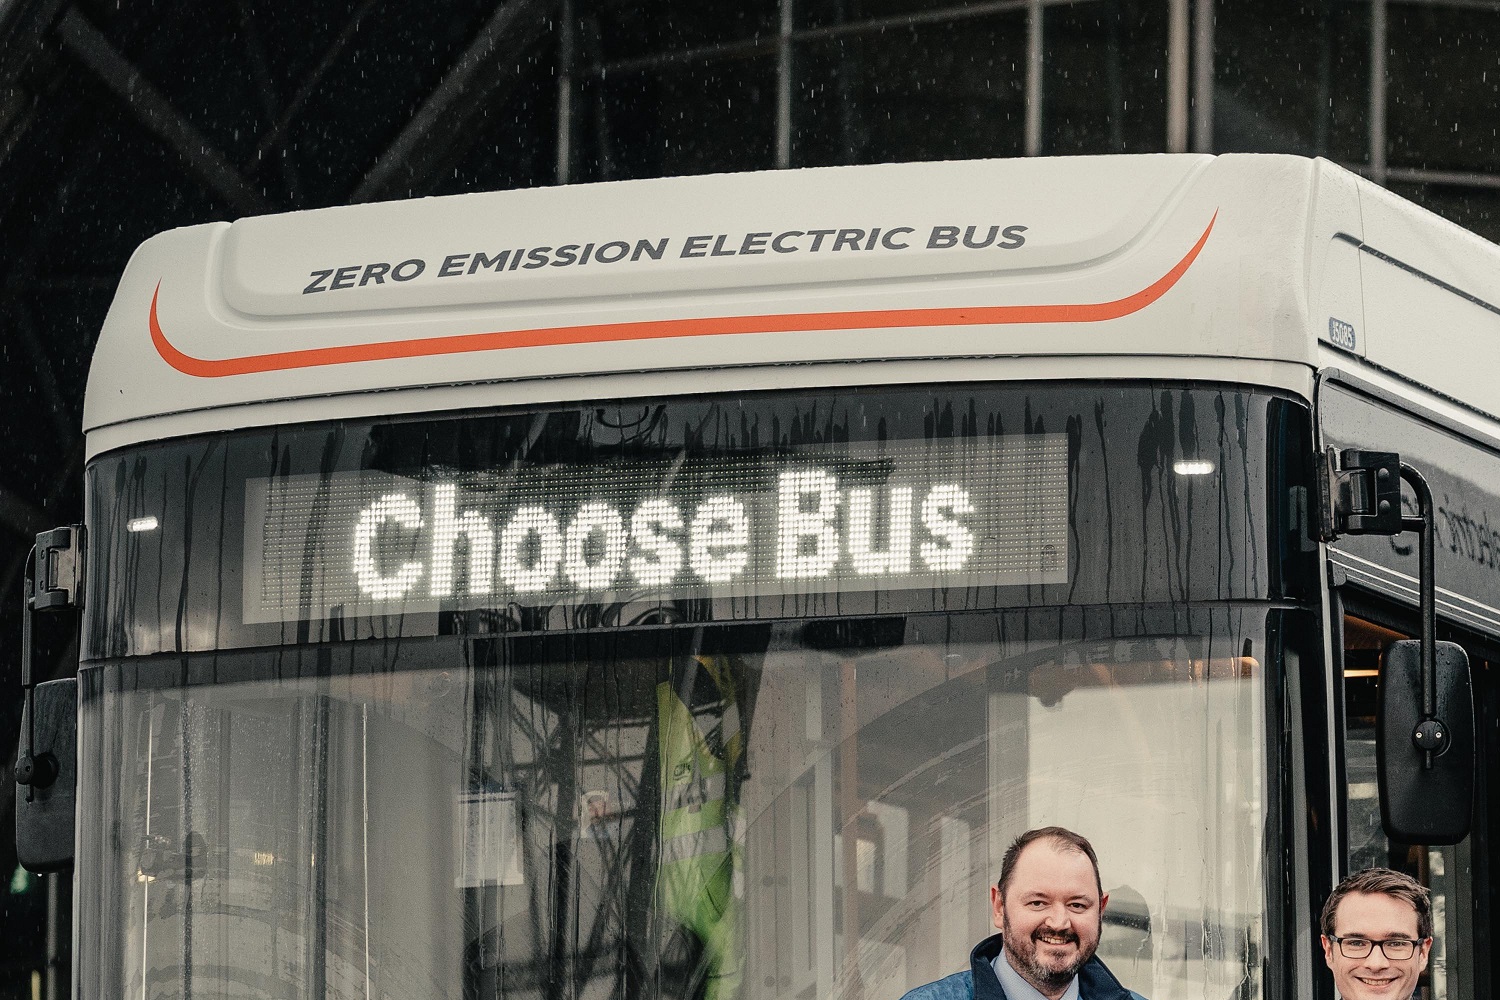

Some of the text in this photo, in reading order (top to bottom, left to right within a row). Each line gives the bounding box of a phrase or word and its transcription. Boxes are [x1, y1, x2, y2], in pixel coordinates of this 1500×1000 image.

[302, 224, 1029, 295] ZERO EMISSION ELECTRIC BUS
[352, 467, 975, 600] Choose Bus
